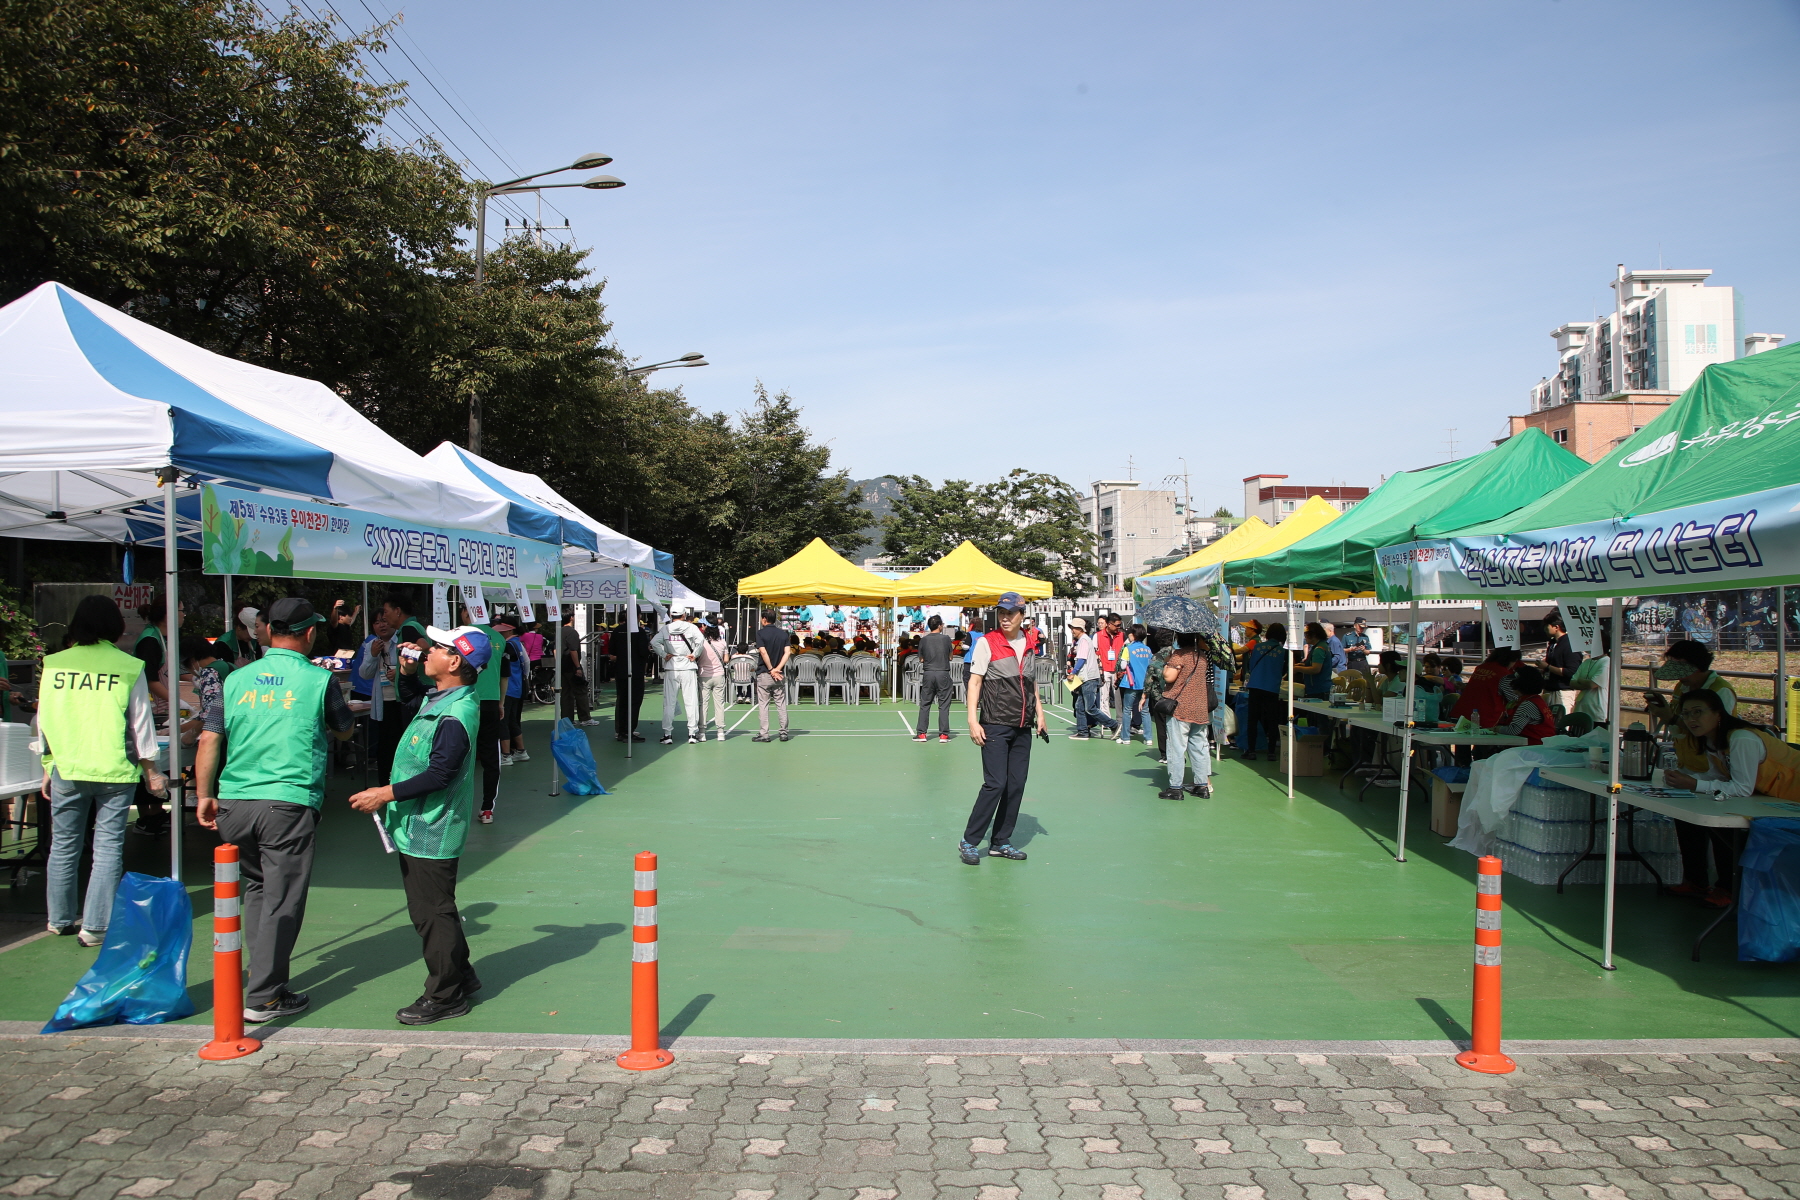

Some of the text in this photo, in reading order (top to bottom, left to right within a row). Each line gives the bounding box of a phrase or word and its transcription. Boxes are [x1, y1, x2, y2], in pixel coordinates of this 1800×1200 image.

[290, 508, 329, 531] 우이천걷기
[1607, 529, 1644, 578] 떡
[1646, 509, 1763, 576] 나눔터
[458, 538, 495, 576] 먹거리
[496, 544, 518, 578] 장터
[1629, 603, 1676, 624] 아기공룡 둘리
[53, 672, 120, 692] STAFF
[254, 674, 285, 686] SMU
